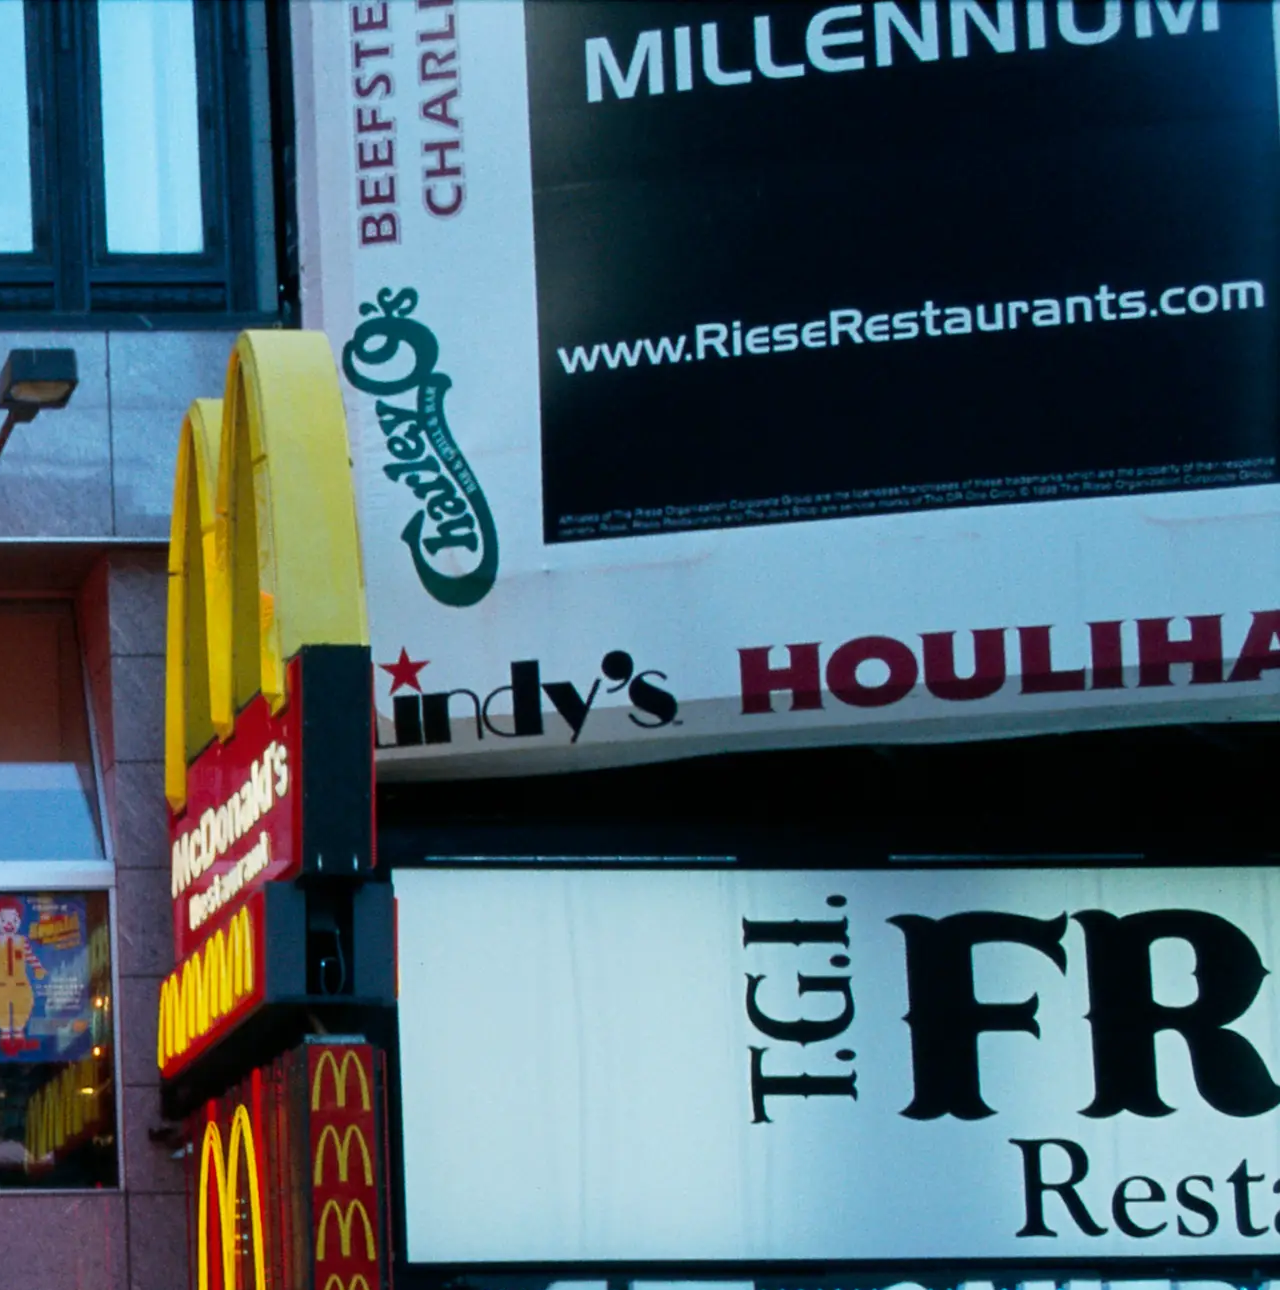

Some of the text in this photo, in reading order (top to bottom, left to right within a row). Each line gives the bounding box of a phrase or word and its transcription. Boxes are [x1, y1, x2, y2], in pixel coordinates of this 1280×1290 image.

[584, 0, 1220, 103] MILLENNIUM
[557, 280, 1264, 374] www.RieseRestaurants.com
[377, 648, 678, 746] indy's
[171, 740, 288, 899] McDonald's
[742, 894, 858, 1124] T.G.I.
[1008, 1137, 1280, 1238] Rest
